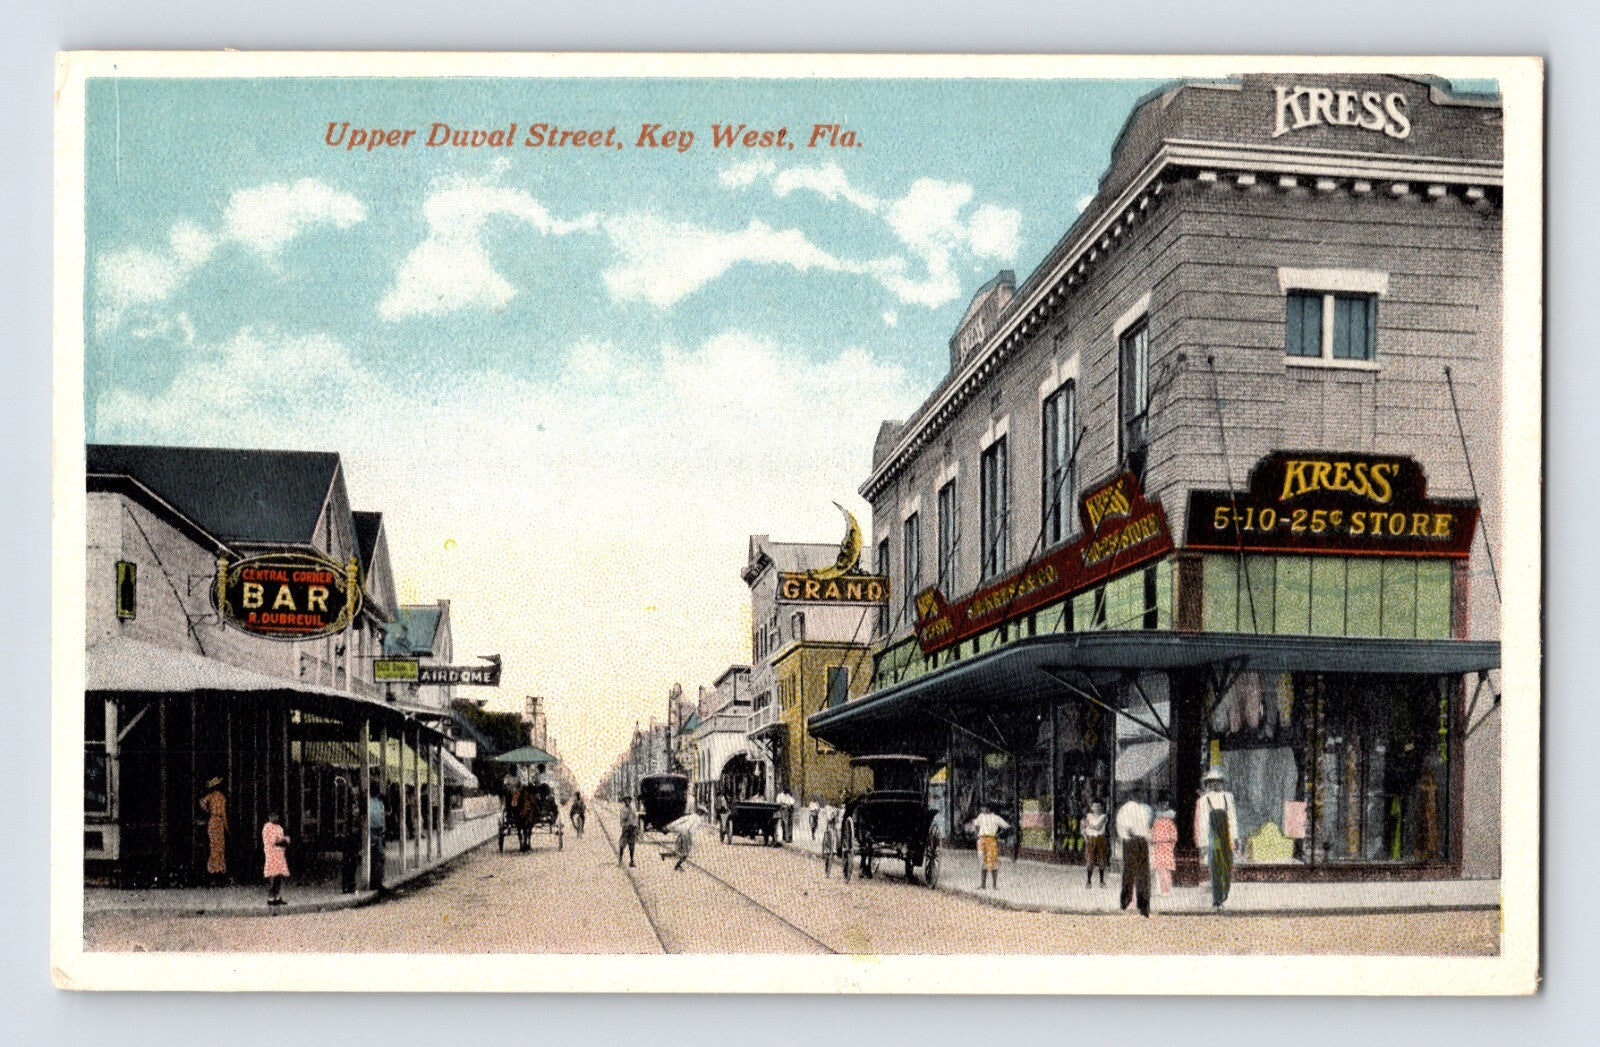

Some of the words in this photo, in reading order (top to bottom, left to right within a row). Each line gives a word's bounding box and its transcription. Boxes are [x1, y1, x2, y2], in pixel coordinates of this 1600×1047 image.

[1271, 85, 1411, 139] KRESS
[1280, 460, 1399, 503] KRESS'
[1350, 511, 1453, 537] STORE
[242, 568, 289, 582] CENTRAL
[292, 570, 333, 584] CORNER
[242, 582, 330, 612] BAR
[782, 580, 883, 601] GRAND
[421, 670, 491, 682] AIRDOME
